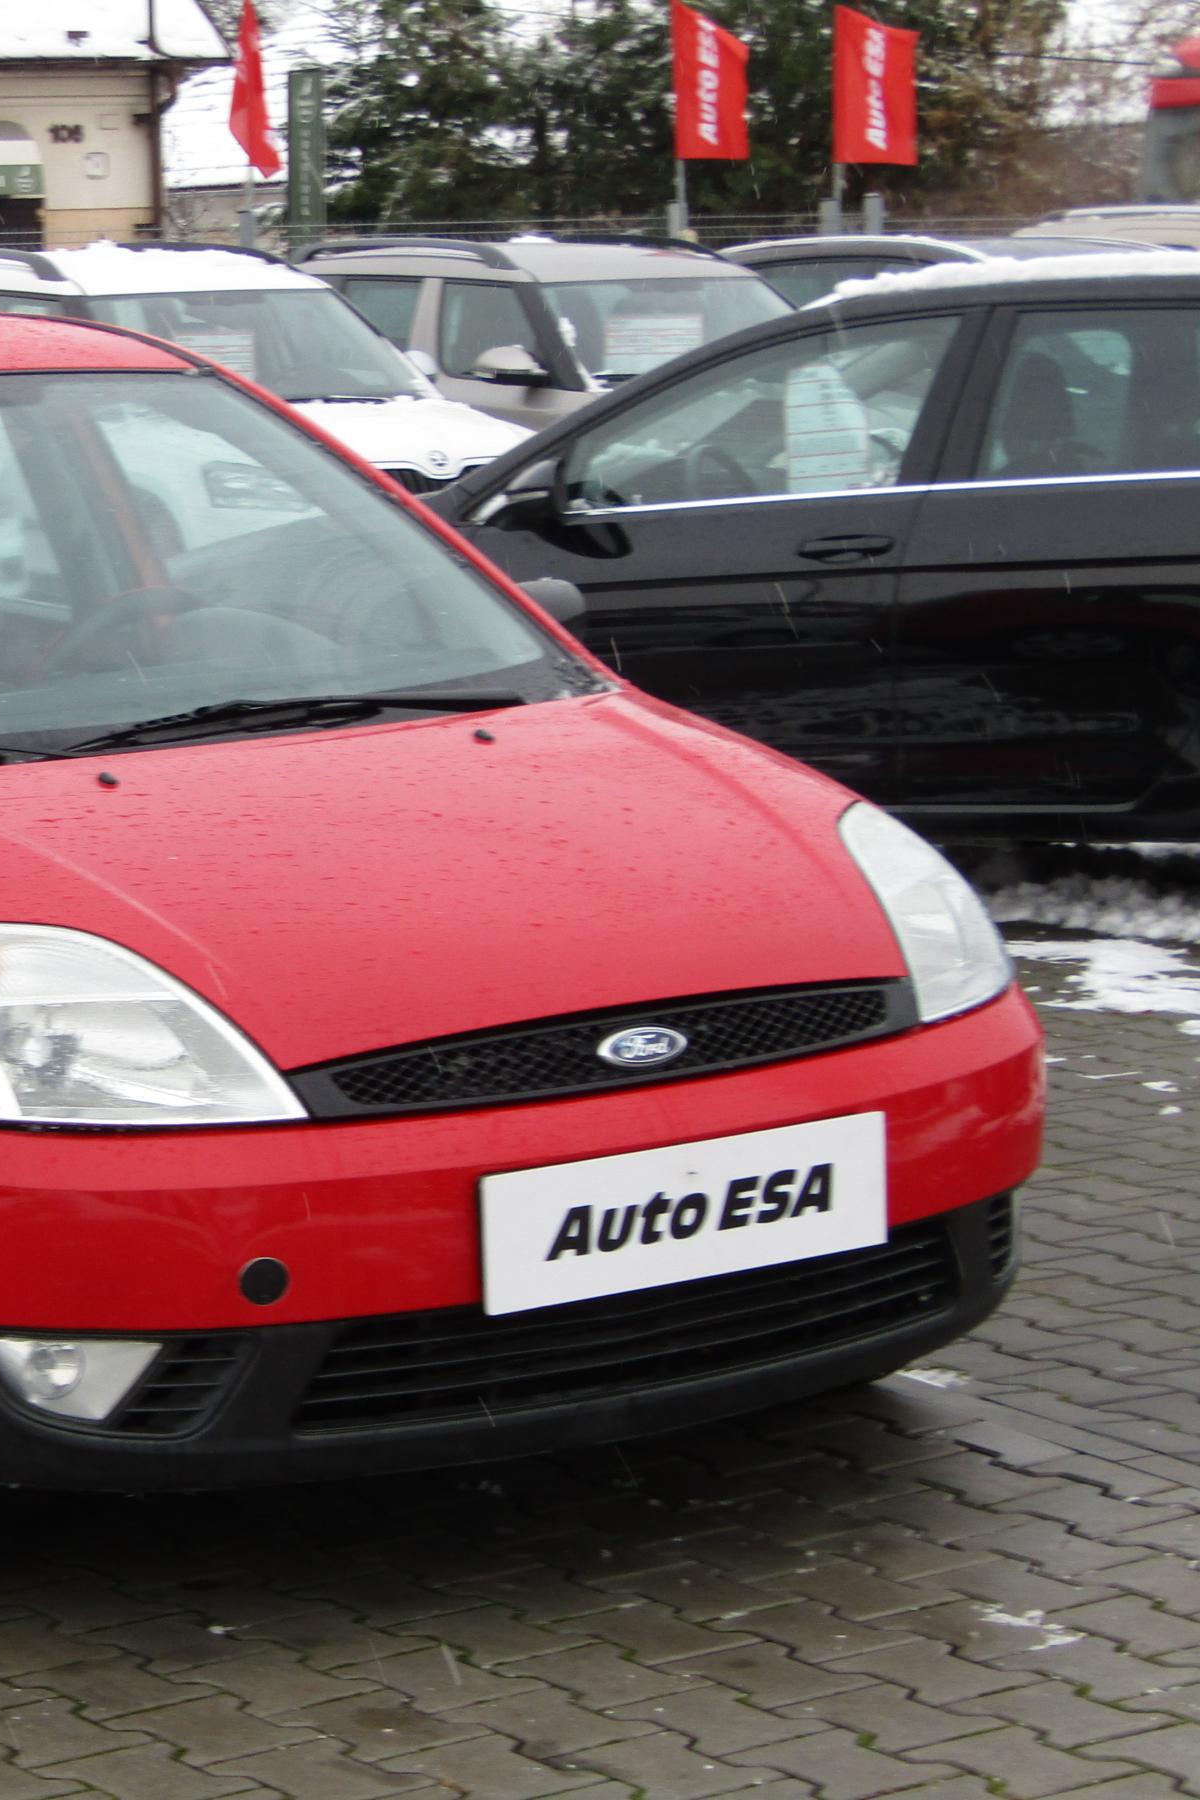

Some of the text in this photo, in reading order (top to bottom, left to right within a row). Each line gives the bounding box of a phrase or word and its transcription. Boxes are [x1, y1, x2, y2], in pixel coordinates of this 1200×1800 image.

[697, 69, 719, 145] Auto
[865, 79, 887, 150] Auto
[619, 1034, 669, 1058] Ford
[545, 1163, 833, 1262] Auto ESA
